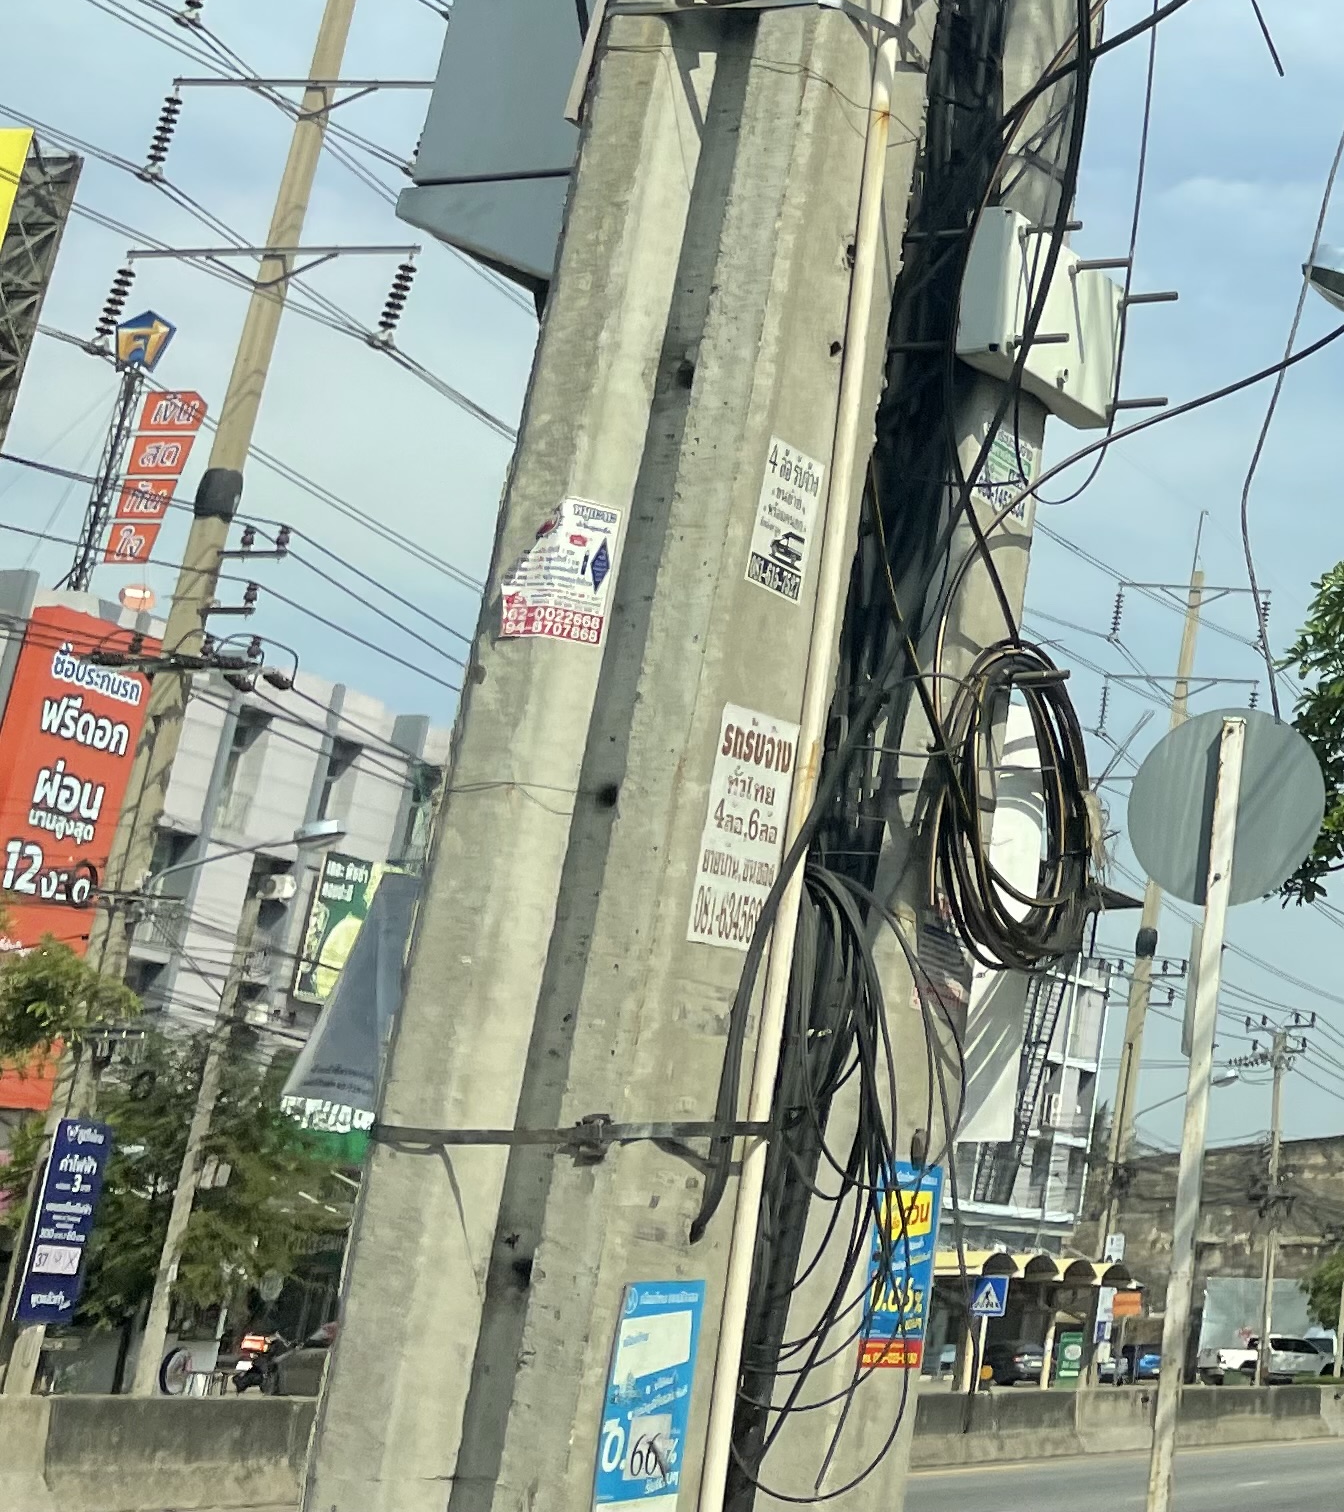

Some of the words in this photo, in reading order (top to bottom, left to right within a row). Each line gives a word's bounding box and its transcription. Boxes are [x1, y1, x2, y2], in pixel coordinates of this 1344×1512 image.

[139, 442, 181, 468] สด
[503, 620, 599, 643] 94-8707868
[41, 695, 129, 757] ฟรีดอก
[32, 759, 105, 821] ผ่อน
[71, 1173, 83, 1193] 3
